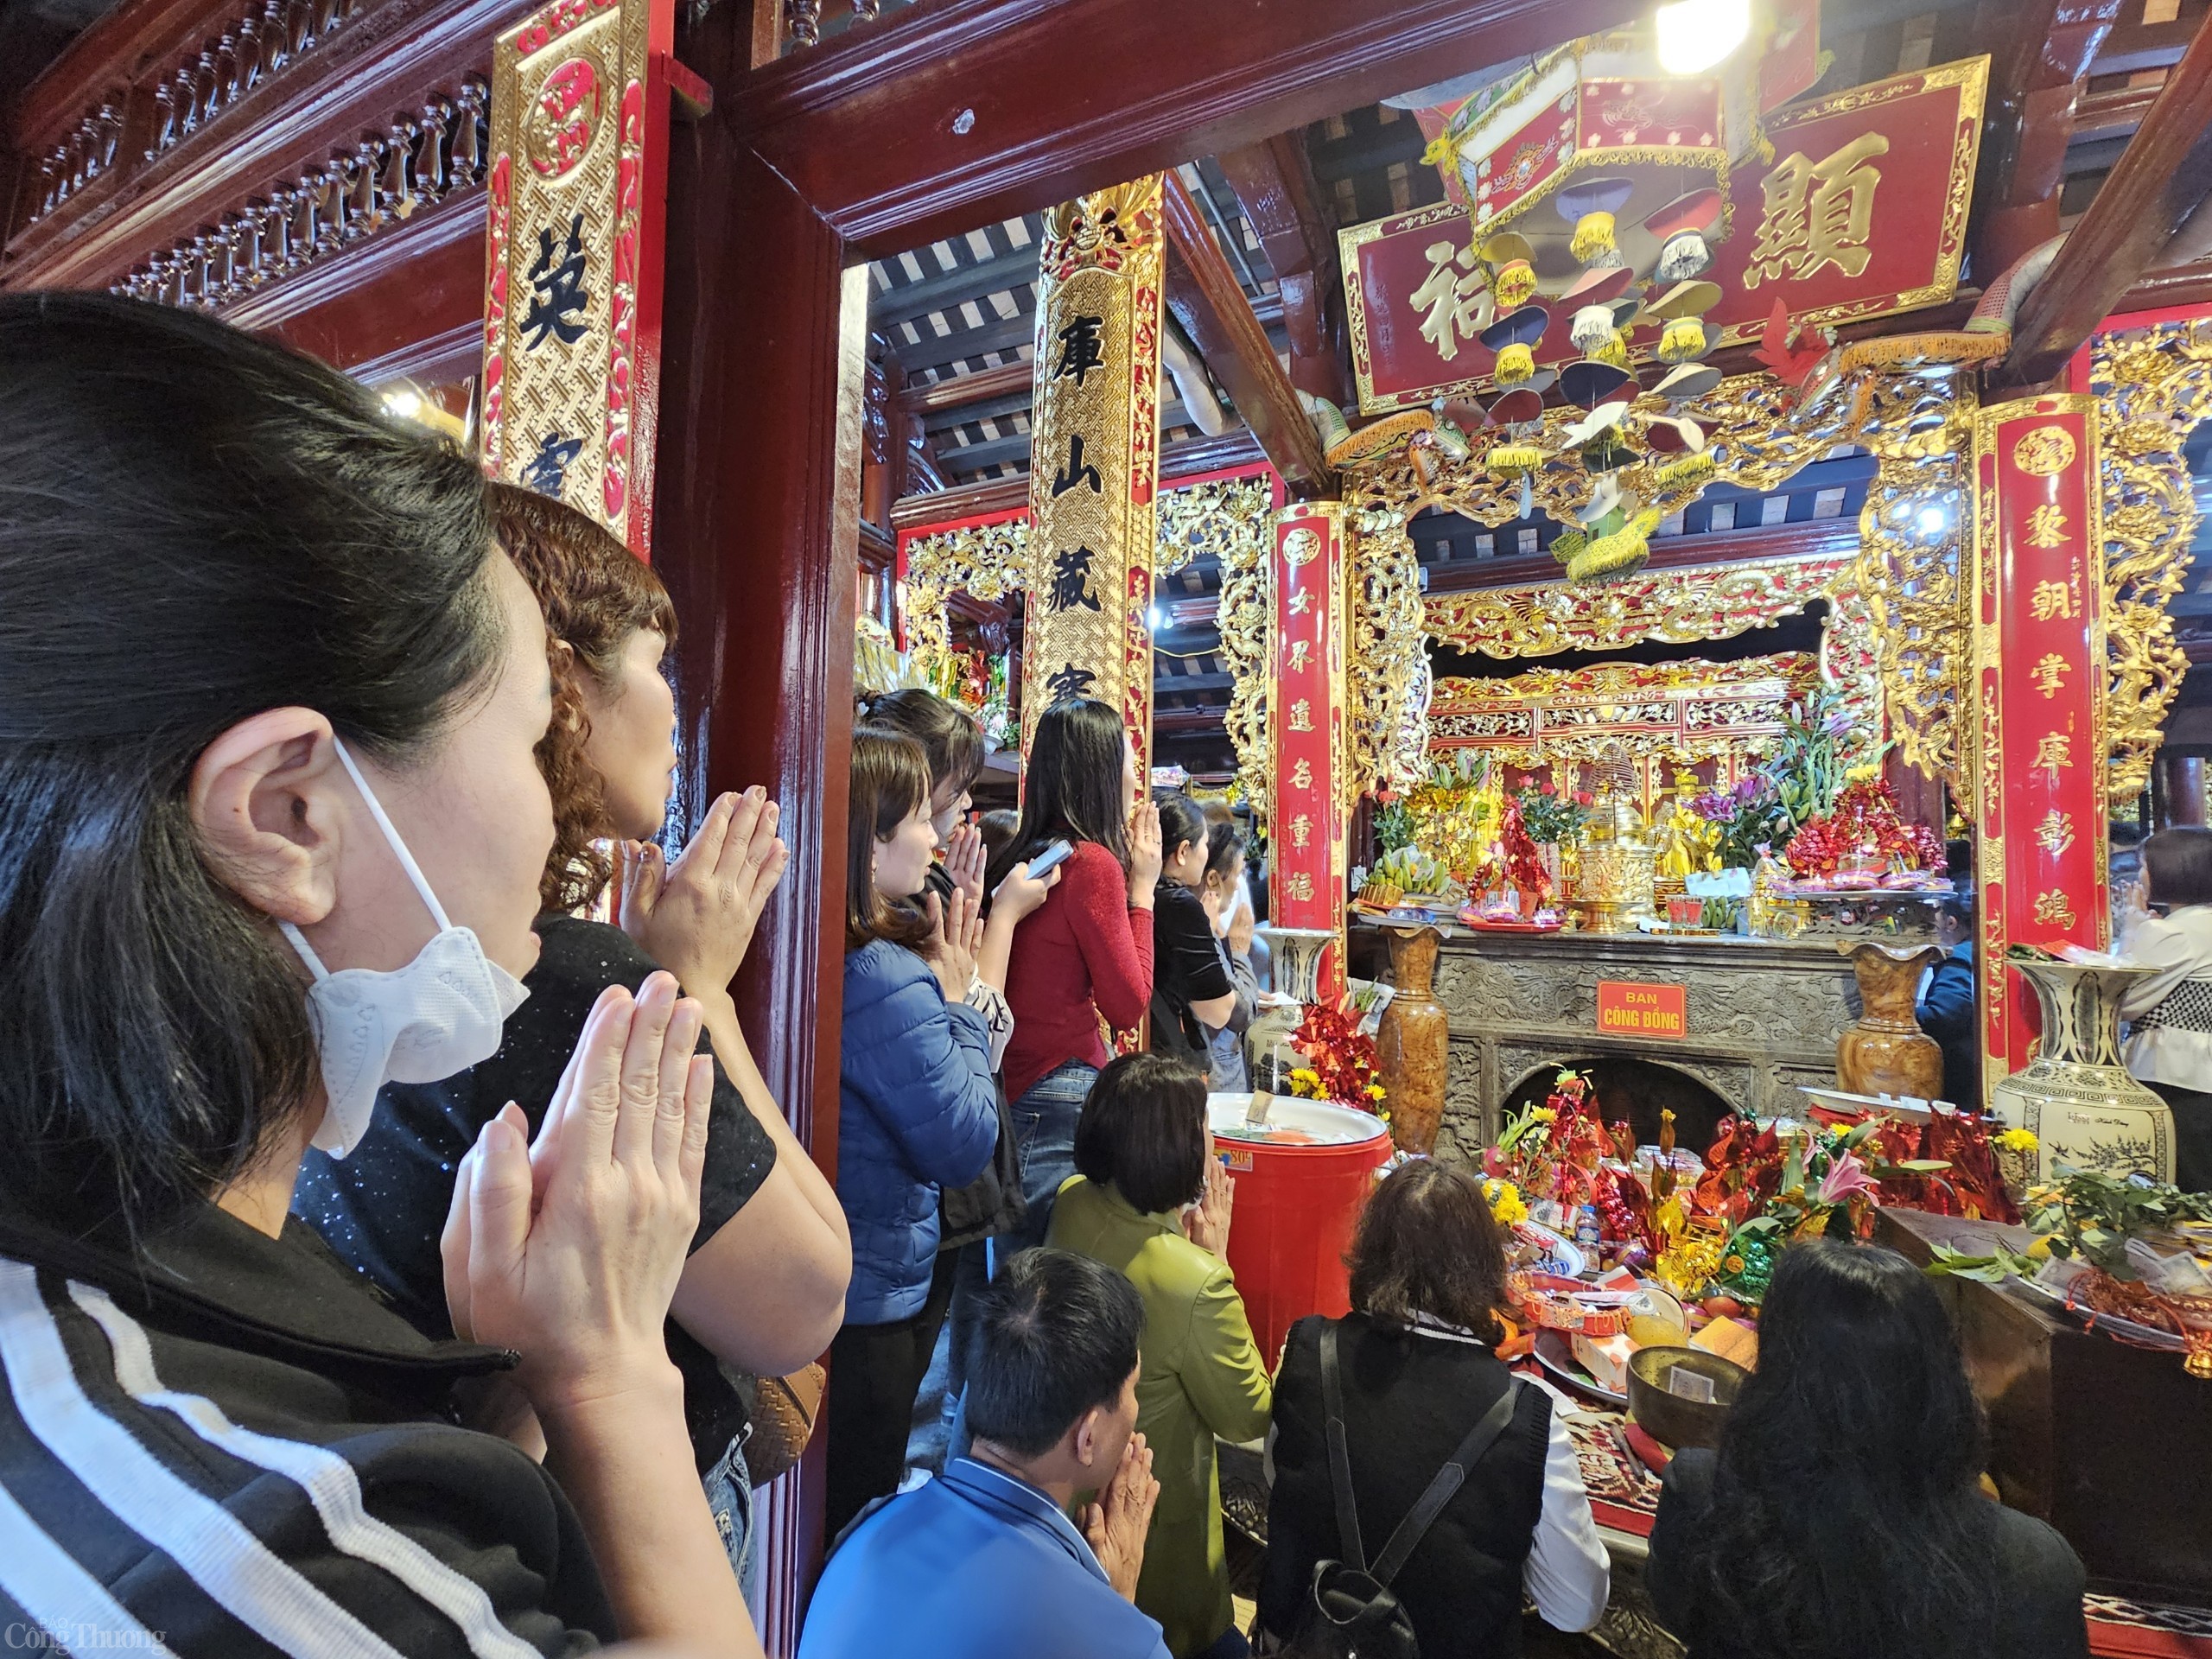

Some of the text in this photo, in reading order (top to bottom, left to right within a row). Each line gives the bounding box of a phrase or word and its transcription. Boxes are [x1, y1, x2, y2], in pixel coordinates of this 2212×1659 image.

[1625, 991, 1657, 1005] BAN
[1604, 1005, 1680, 1030] CÔNG ĐỒNG
